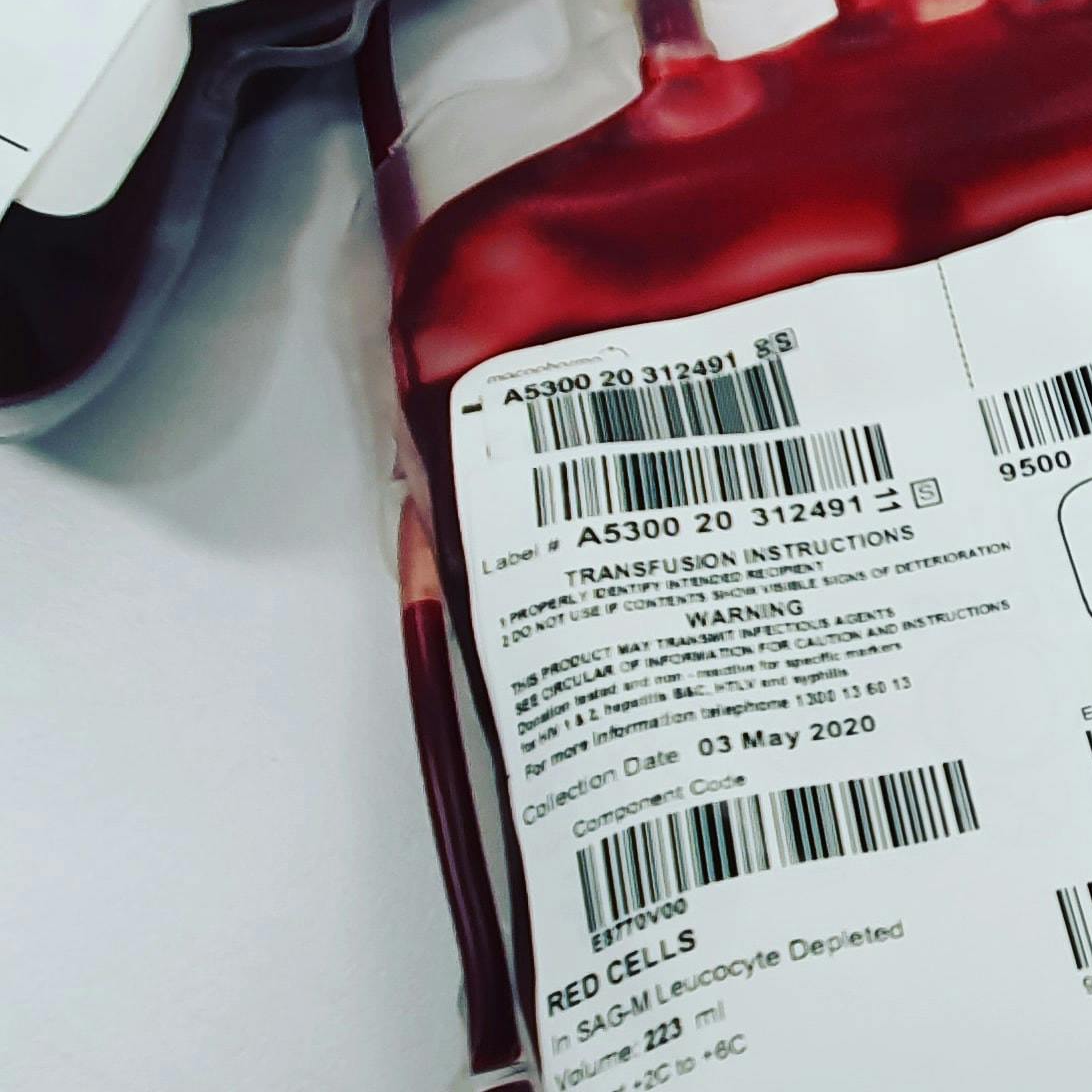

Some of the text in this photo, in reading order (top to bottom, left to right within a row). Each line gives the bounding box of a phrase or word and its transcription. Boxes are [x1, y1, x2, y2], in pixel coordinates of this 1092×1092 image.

[504, 373, 593, 406] A5300
[600, 368, 634, 387] 20
[641, 351, 738, 385] 312491
[998, 450, 1072, 482] 9500
[482, 543, 539, 574] Label
[577, 516, 680, 548] A5300
[694, 510, 733, 534] 20
[751, 494, 862, 527] 312491
[875, 488, 902, 513] 11
[564, 524, 915, 584] TRANSFUSION INSTRUCTIONS
[871, 566, 889, 579] OF
[894, 542, 1011, 575] DETERIORATION
[685, 600, 804, 629] WARNING
[841, 684, 862, 699] 13
[892, 675, 912, 690] 13
[522, 714, 876, 826] Collection Date 03 May 2020
[572, 775, 746, 838] Component Code
[547, 928, 696, 1017] RED CELLS
[577, 922, 904, 1043] SAG-M Leucocyte Depleted
[644, 1016, 683, 1053] 223
